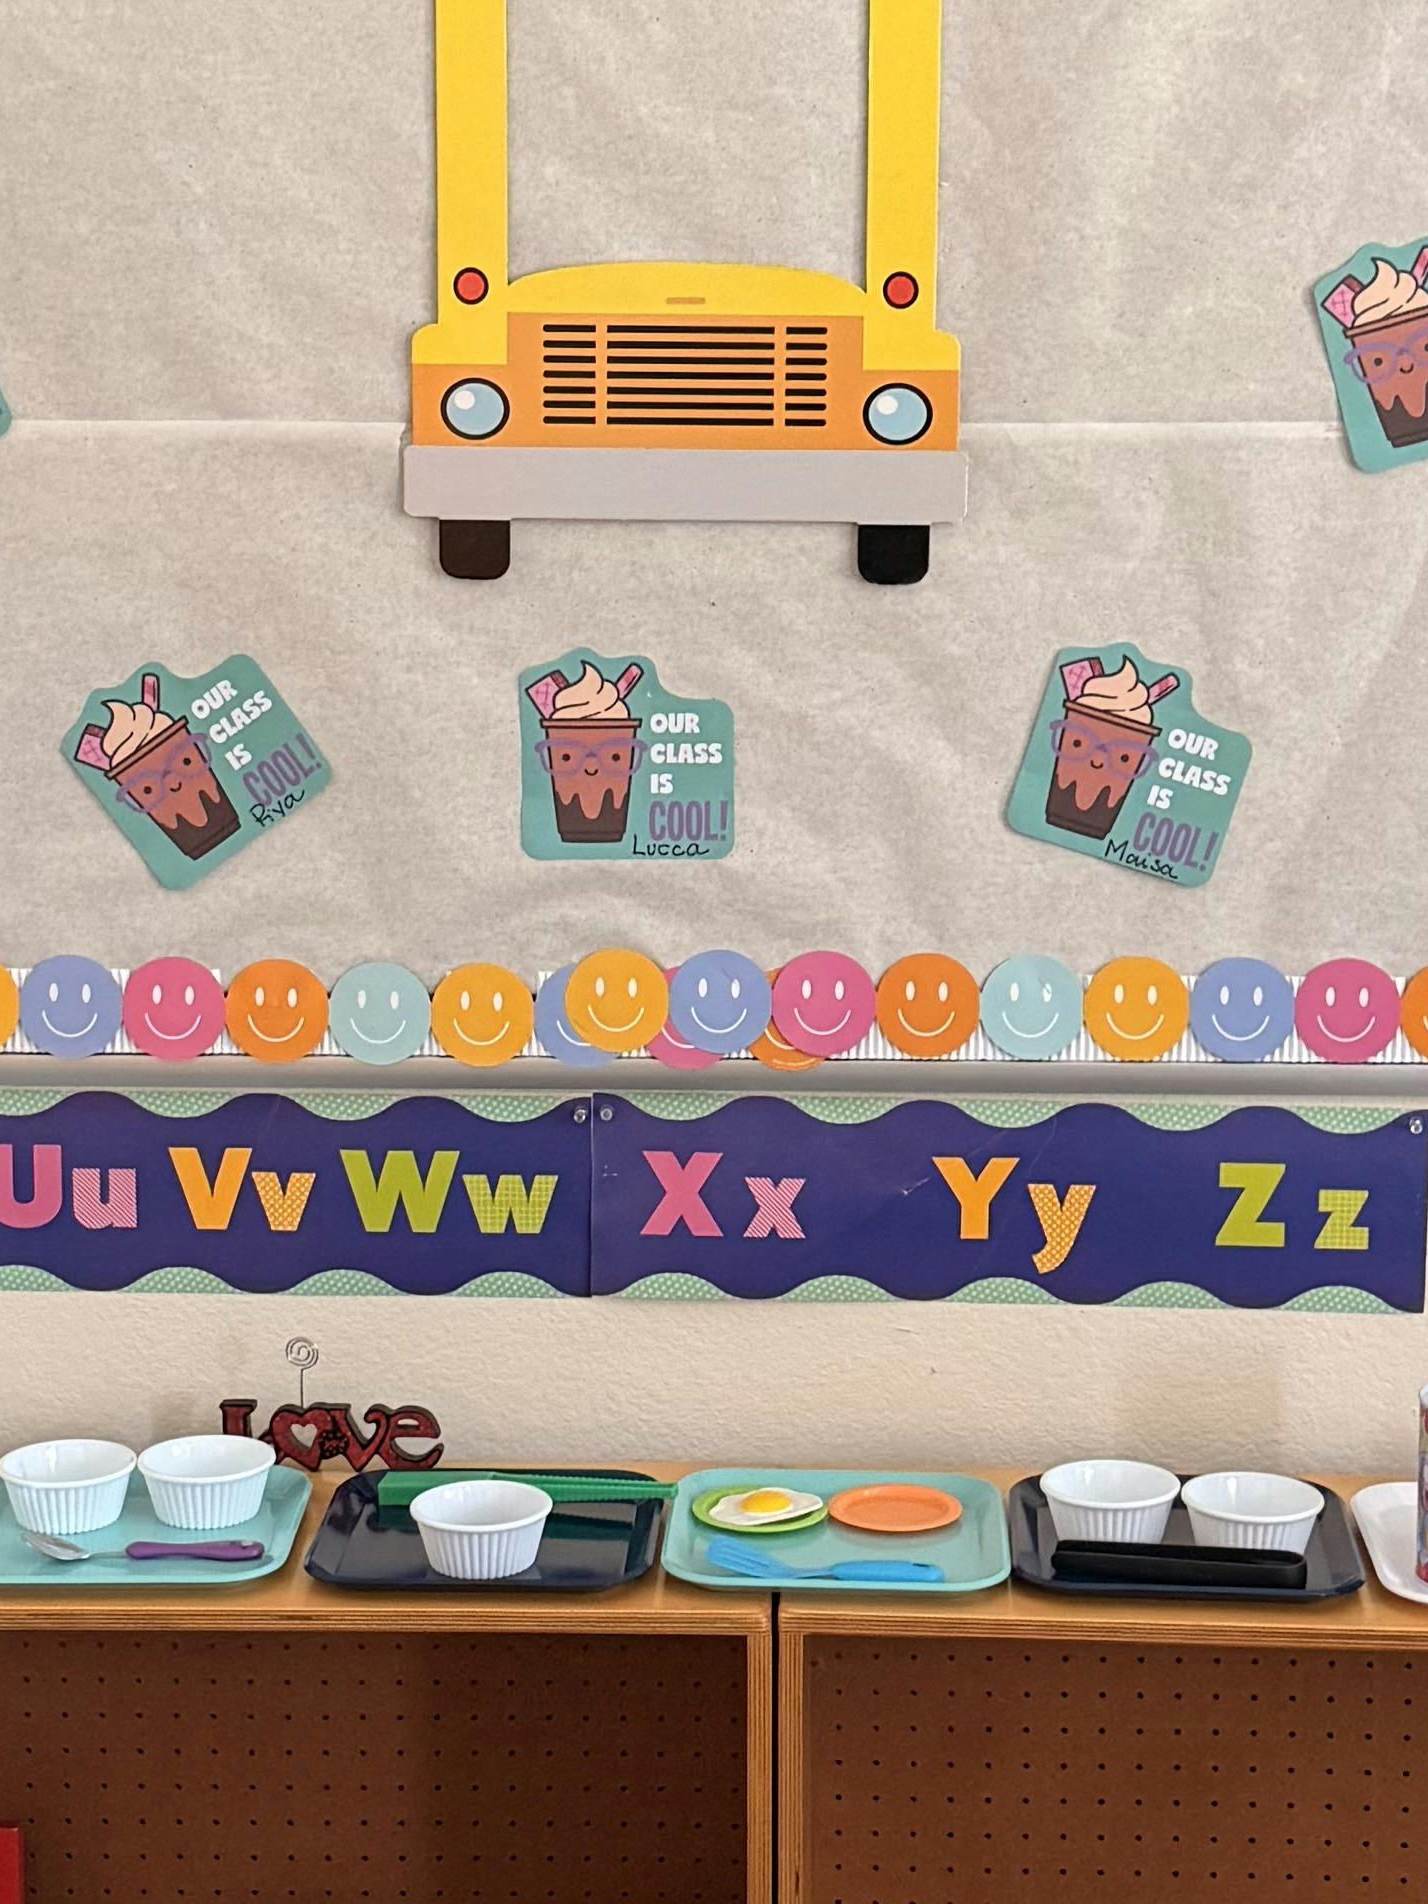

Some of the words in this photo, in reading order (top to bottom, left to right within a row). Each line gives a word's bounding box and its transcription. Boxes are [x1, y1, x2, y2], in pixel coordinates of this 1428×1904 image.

[191, 679, 238, 720] OUR
[209, 690, 273, 744] CLASS
[650, 713, 700, 734] OUR
[224, 743, 253, 771] IS
[650, 743, 723, 764] CLASS
[1168, 728, 1219, 761] OUR
[242, 733, 322, 807] COOL!
[650, 773, 673, 794] IS
[1158, 757, 1231, 796] CLASS
[249, 789, 305, 828] Riya
[1147, 785, 1173, 810] IS
[648, 800, 729, 841] COOL!
[632, 834, 710, 856] Lucca
[1132, 811, 1219, 872] COOL!
[169, 1146, 314, 1232] Vv
[340, 1150, 558, 1235] Ww
[641, 1152, 804, 1240] Xx
[934, 1157, 1095, 1273] Yy
[1215, 1164, 1369, 1251] Zz
